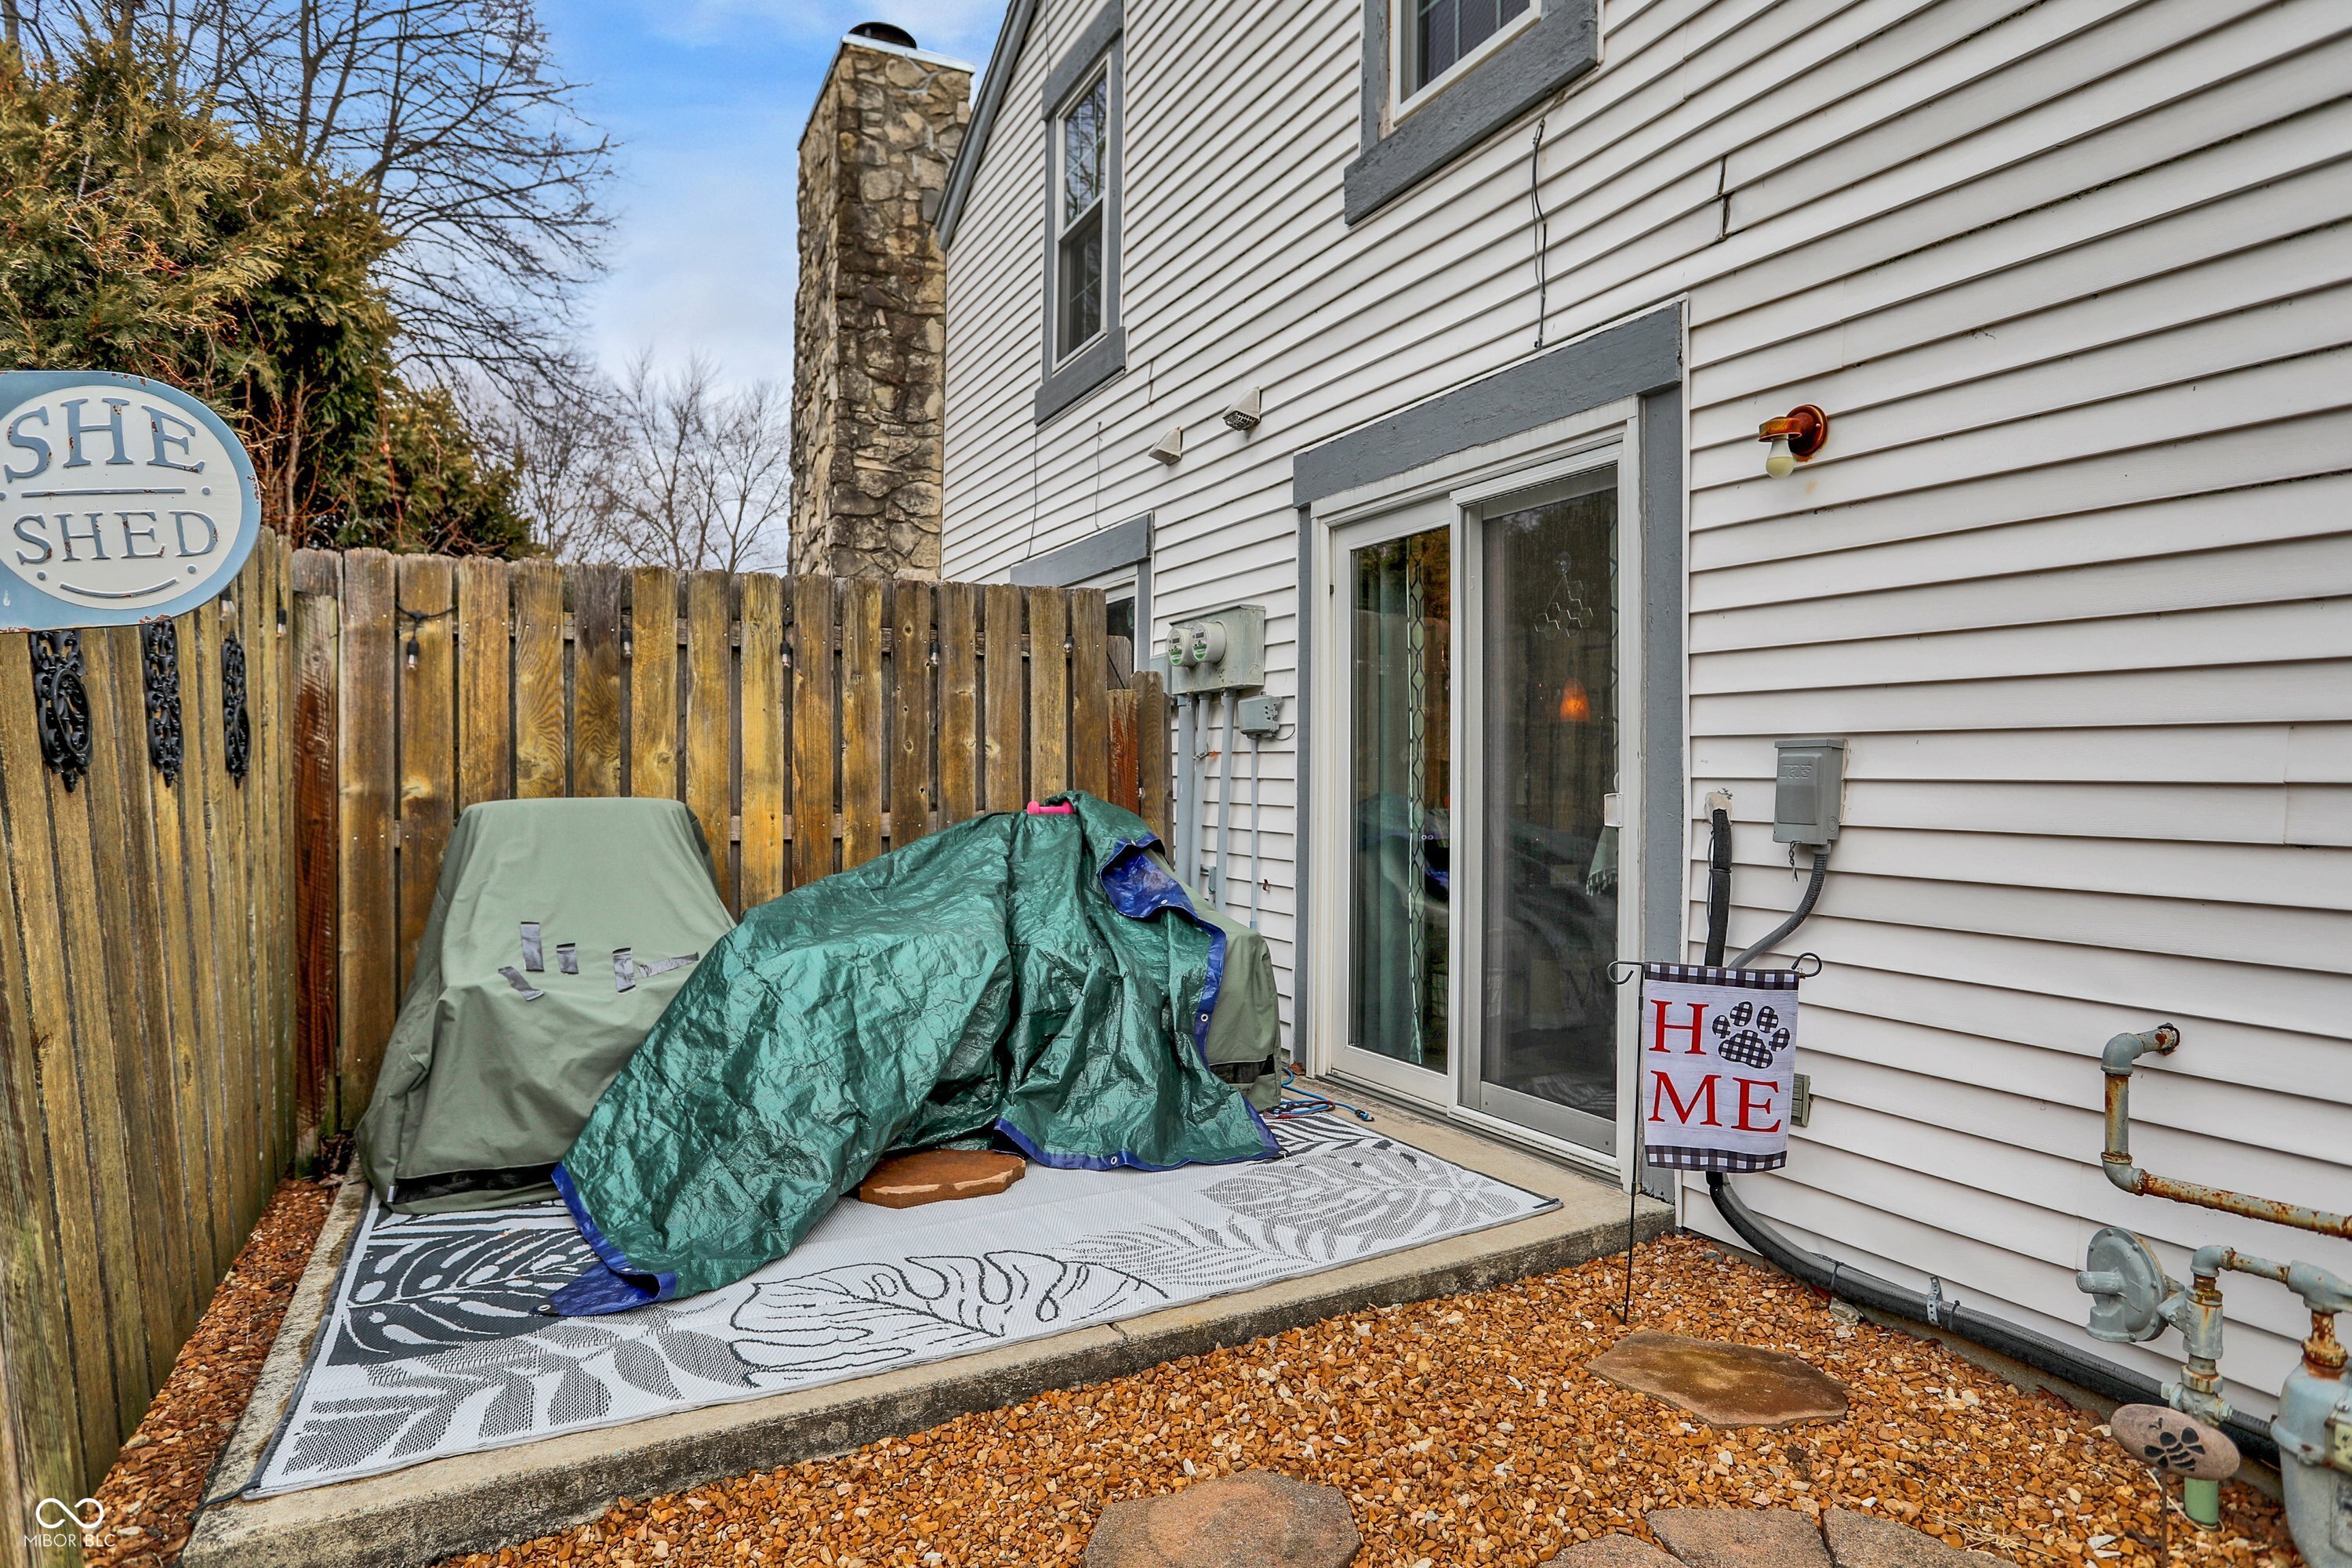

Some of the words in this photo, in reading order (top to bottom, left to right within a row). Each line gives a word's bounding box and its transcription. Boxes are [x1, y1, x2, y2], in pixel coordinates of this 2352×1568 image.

[4, 397, 206, 484] SHE
[13, 510, 220, 565] SHED
[1648, 1069, 1782, 1134] ME
